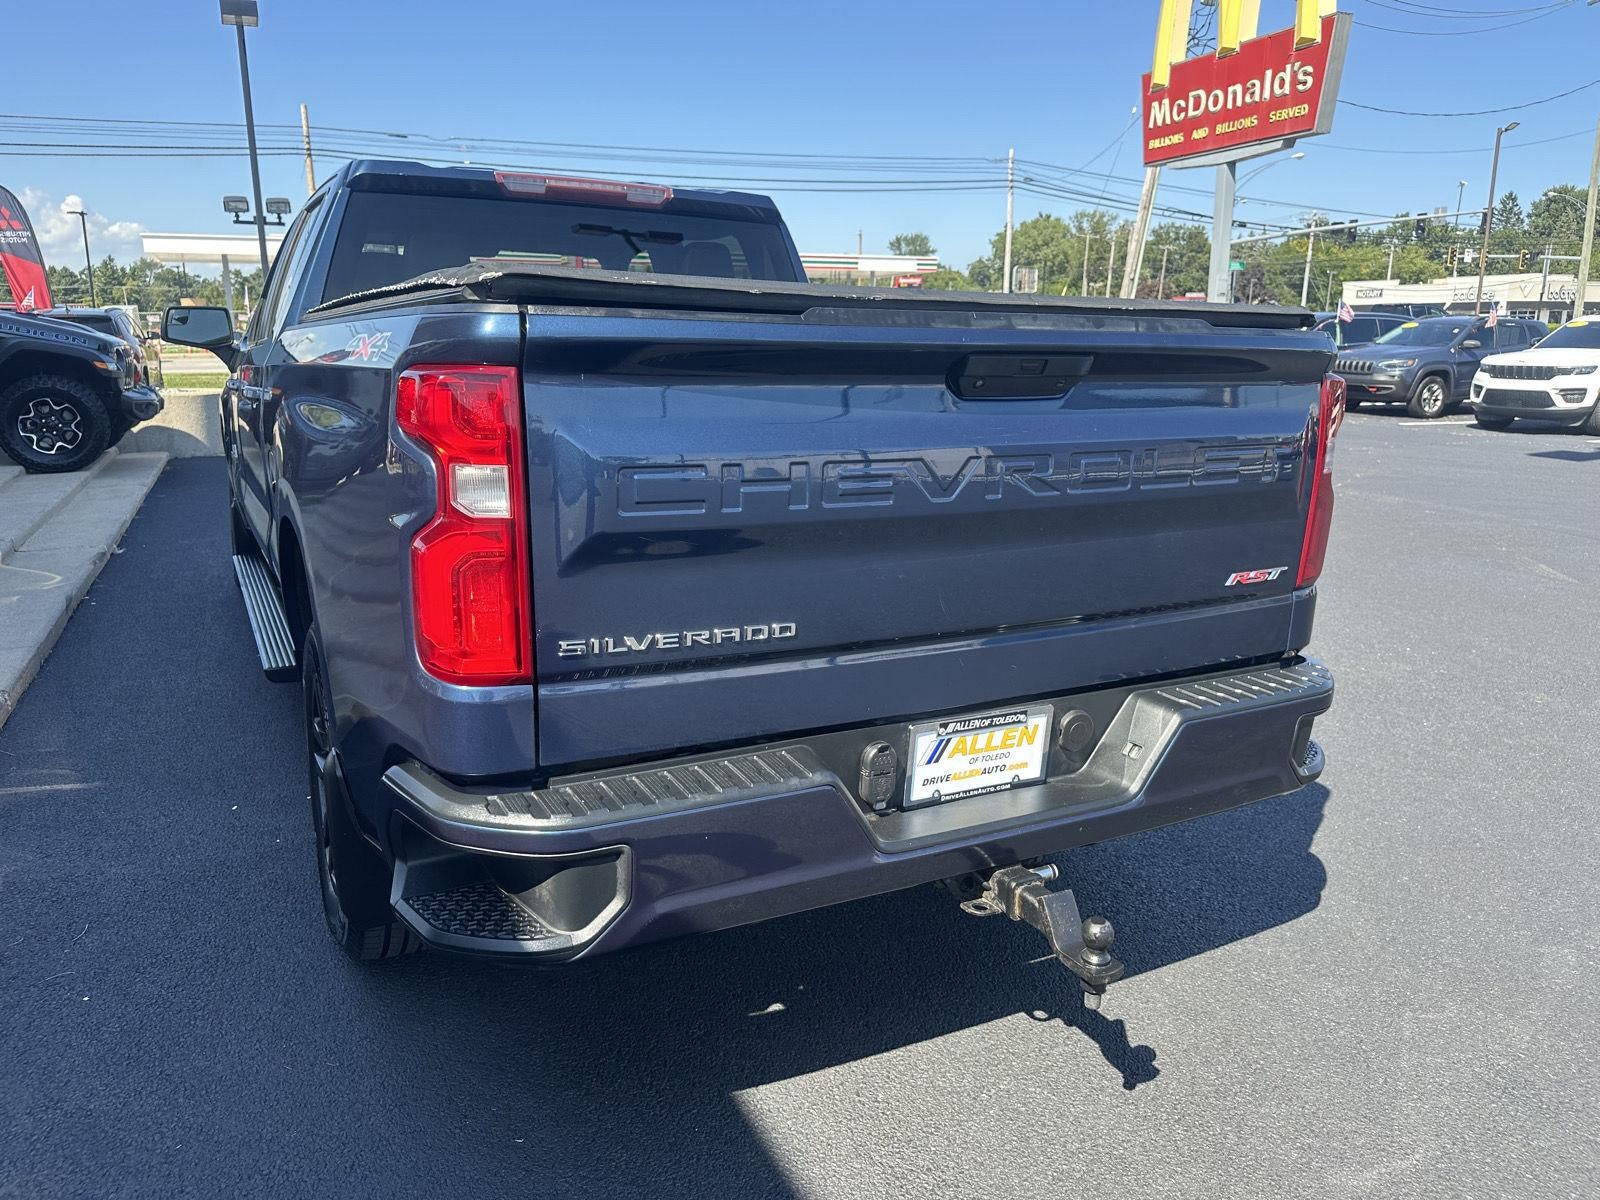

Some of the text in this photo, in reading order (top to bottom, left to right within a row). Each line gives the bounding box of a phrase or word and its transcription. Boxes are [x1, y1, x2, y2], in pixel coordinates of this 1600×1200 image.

[1149, 61, 1314, 129] McDonald's
[1148, 103, 1309, 150] BILLIONS AND BILLIONS SERVED
[1357, 289, 1383, 298] NOTARY
[1452, 285, 1496, 301] balace
[617, 445, 1297, 517] CHEVROLET
[1225, 566, 1289, 586] RST
[558, 622, 797, 656] SILVERADO
[954, 713, 1021, 731] ALLEN OF TOLEDO
[948, 724, 1039, 758] ALLEN
[969, 751, 1011, 765] OF TOLEDO
